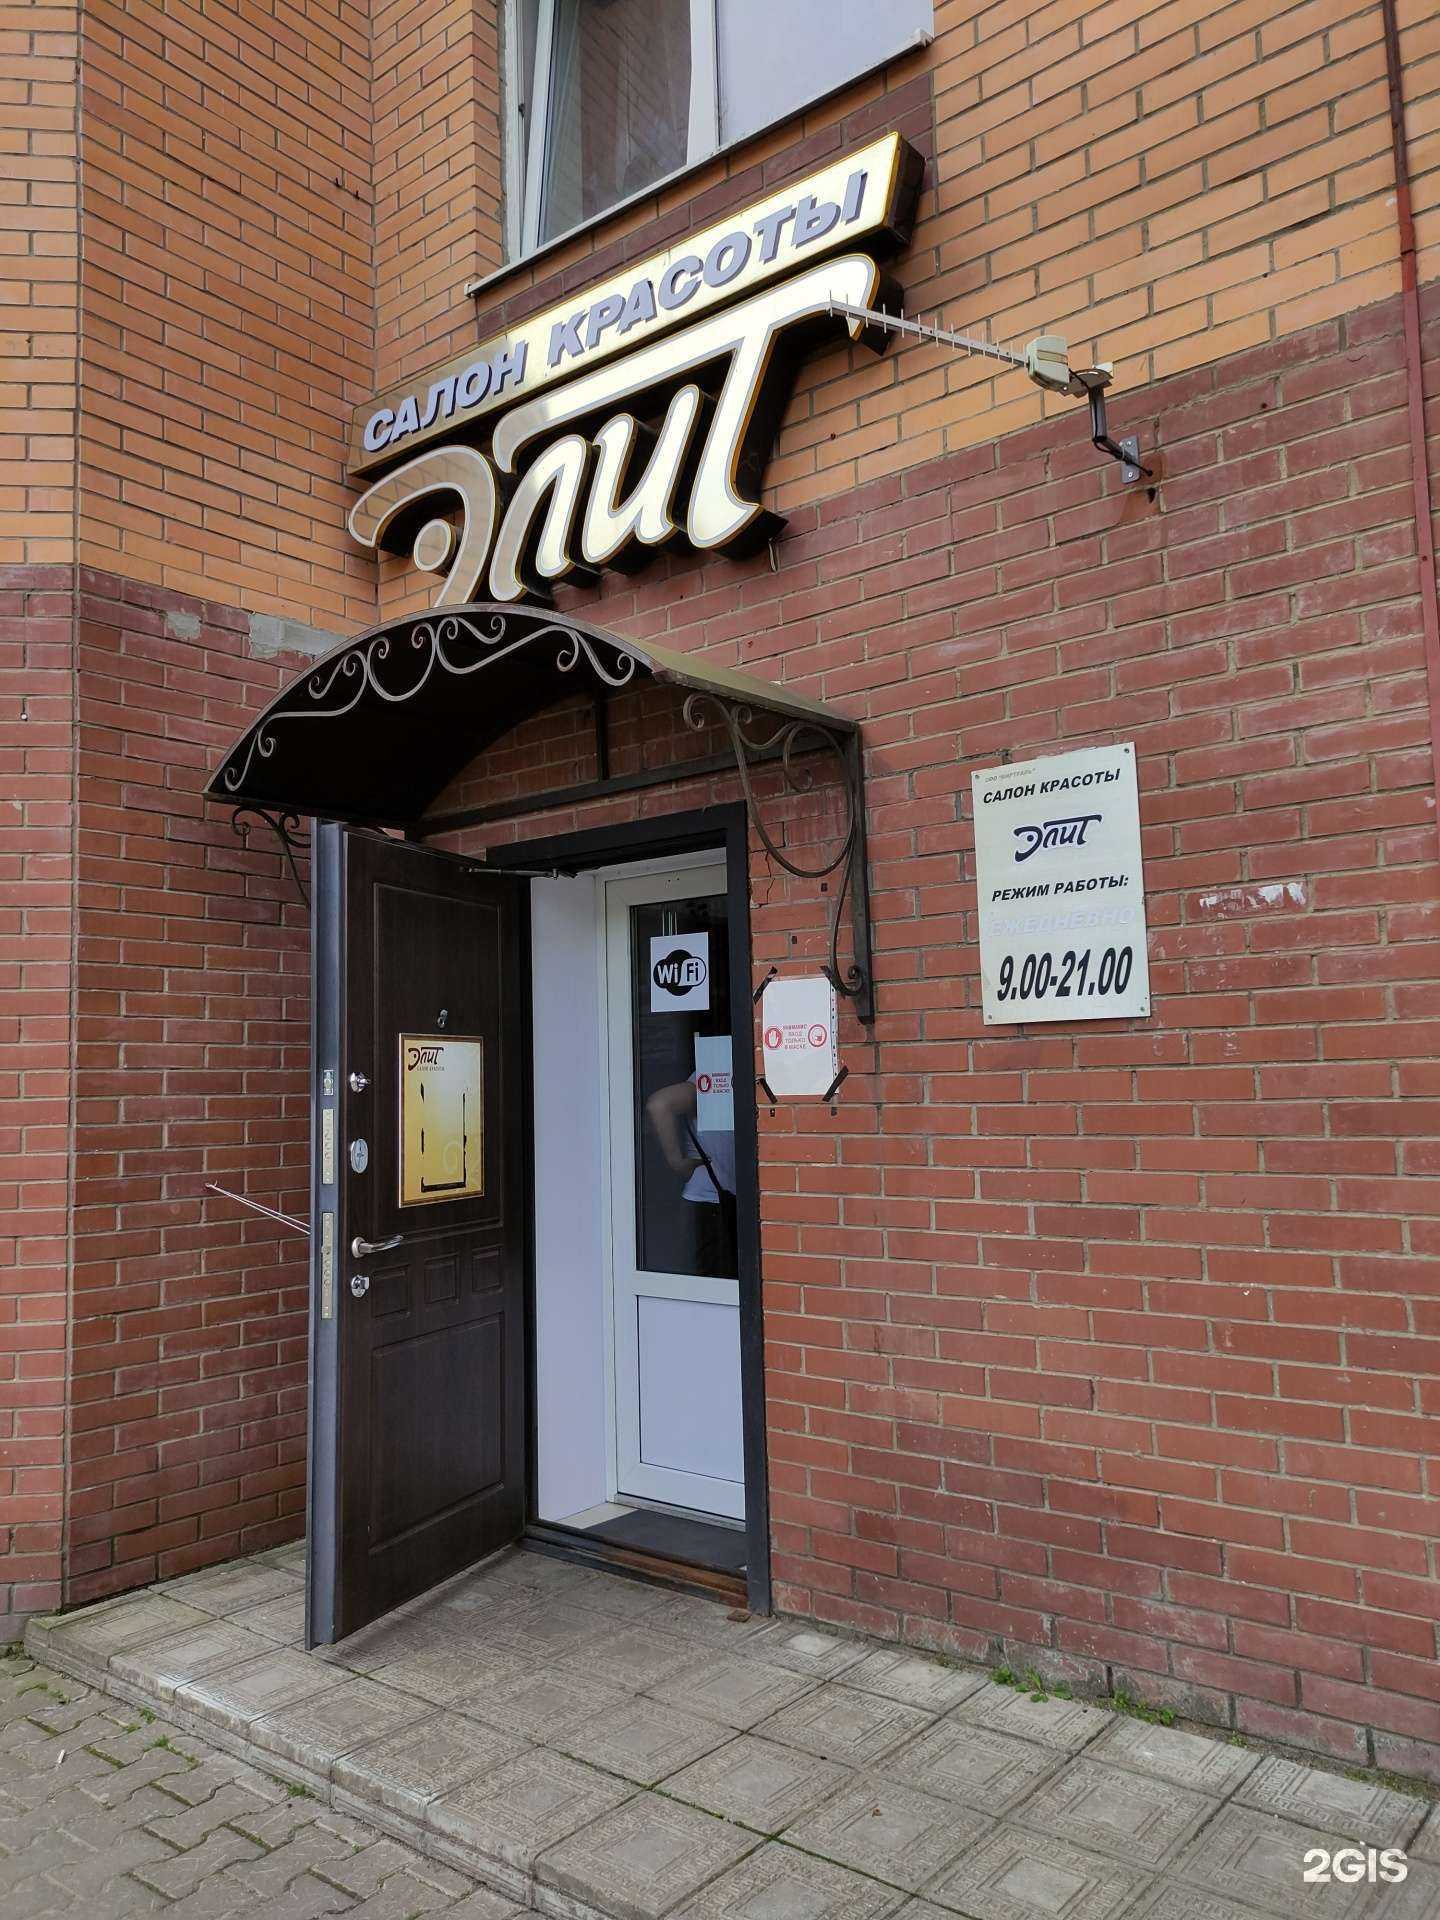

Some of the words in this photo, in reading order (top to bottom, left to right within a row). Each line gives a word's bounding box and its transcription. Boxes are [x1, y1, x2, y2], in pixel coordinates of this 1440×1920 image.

[363, 340, 530, 453] САЛОН
[546, 168, 869, 368] КРАСОТЫ
[983, 783, 1036, 804] САЛОН
[1039, 768, 1121, 794] КРАСОТЫ
[991, 882, 1050, 902] РЕЖИМ
[1053, 874, 1130, 896] РАБОТЫ:
[996, 946, 1133, 1002] 9.00-21.00
